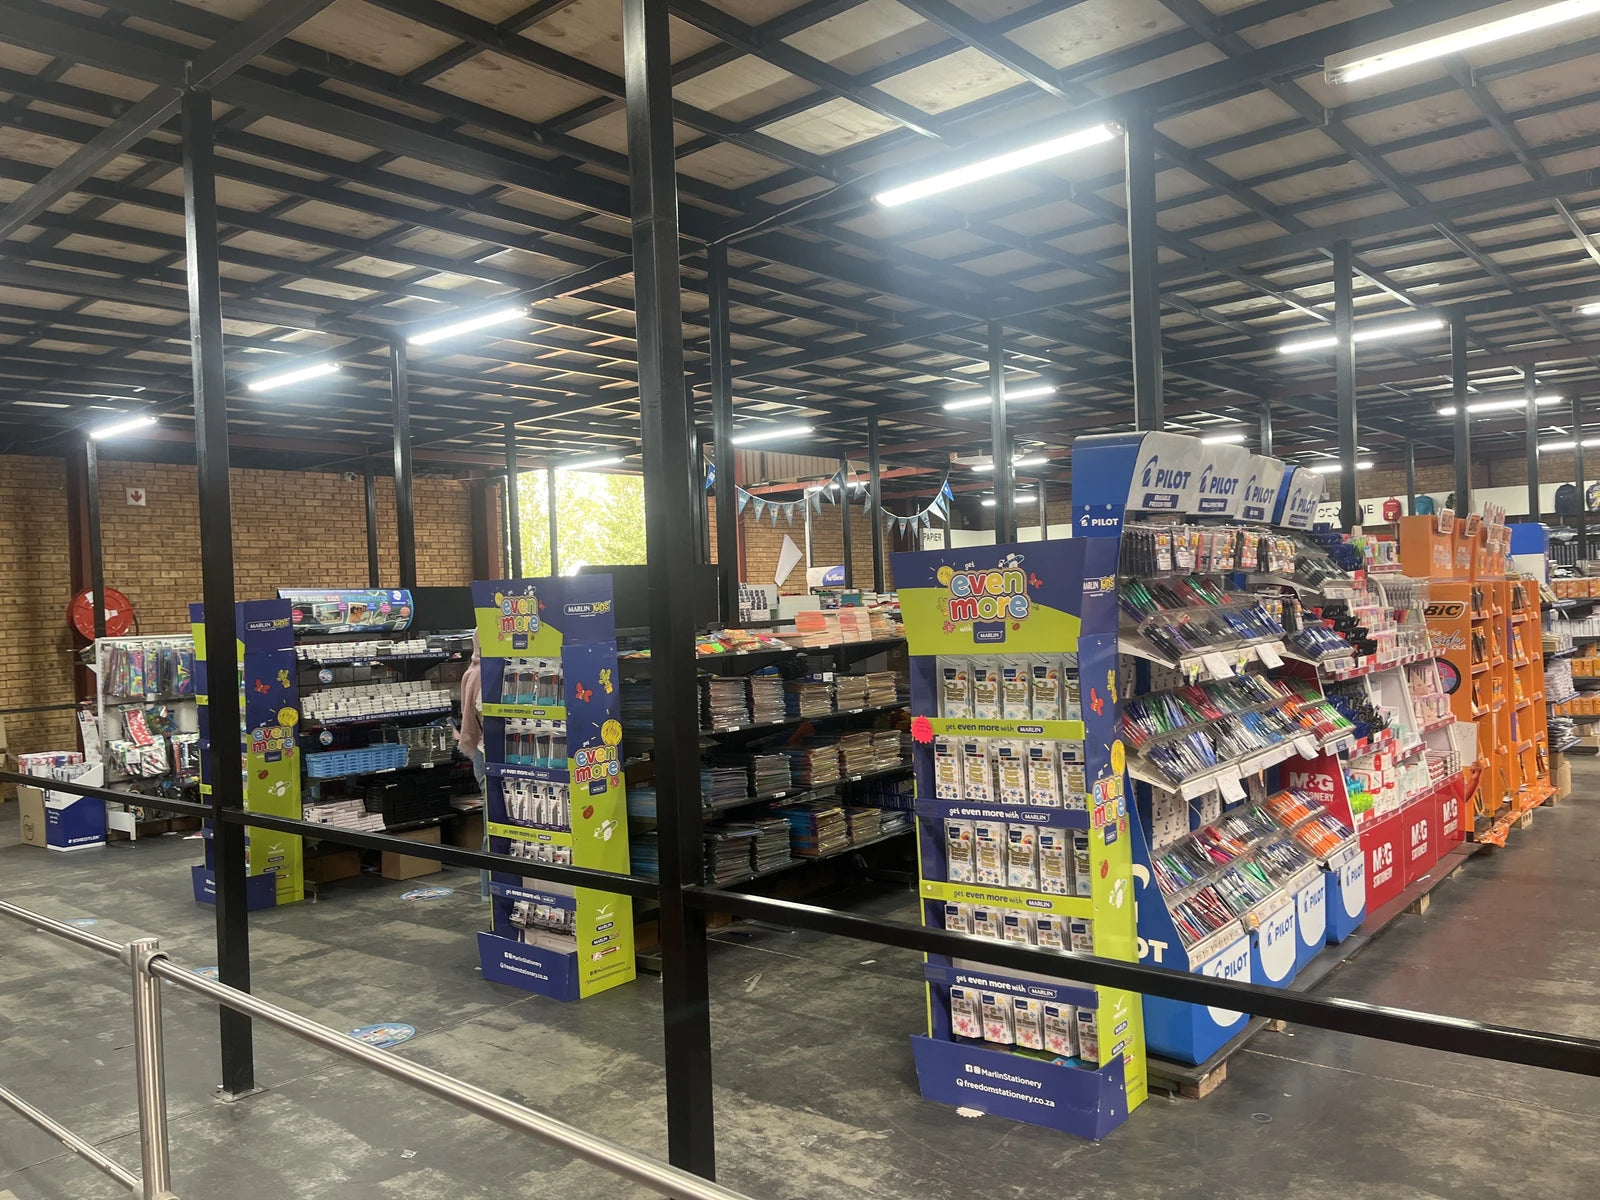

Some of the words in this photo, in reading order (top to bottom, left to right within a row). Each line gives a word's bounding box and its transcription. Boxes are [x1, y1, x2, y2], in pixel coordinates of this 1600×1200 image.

[1155, 469, 1191, 490] PILOT
[1210, 476, 1239, 495] PILOT
[1252, 486, 1275, 504] PILOT
[1092, 518, 1119, 526] PILOT
[964, 561, 976, 570] get
[951, 570, 1024, 597] even
[502, 596, 538, 615] even
[568, 604, 590, 613] MARLIN
[950, 594, 1028, 621] more
[502, 615, 539, 633] more
[253, 727, 291, 741] even
[978, 724, 1000, 732] more
[252, 738, 294, 753] more
[576, 746, 616, 766] even
[574, 760, 619, 783] more
[1094, 776, 1122, 806] even
[1290, 772, 1334, 792] M&G
[962, 808, 981, 816] even
[982, 810, 1005, 818] more
[1094, 797, 1125, 828] more
[1443, 798, 1458, 823] M&G
[1411, 819, 1428, 846] M&G
[1373, 842, 1392, 873] M&G
[966, 892, 984, 900] even
[986, 894, 1008, 902] more
[1028, 900, 1050, 908] MARLIN
[1310, 886, 1324, 908] PILOT
[1275, 914, 1294, 941] PILOT
[1224, 952, 1248, 980] PILOT
[968, 976, 988, 986] even
[988, 980, 1012, 989] more
[1032, 988, 1054, 996] MARLIN
[982, 1068, 1042, 1089] MarlinStationery
[964, 1079, 1056, 1108] freedomstationery.co.za
